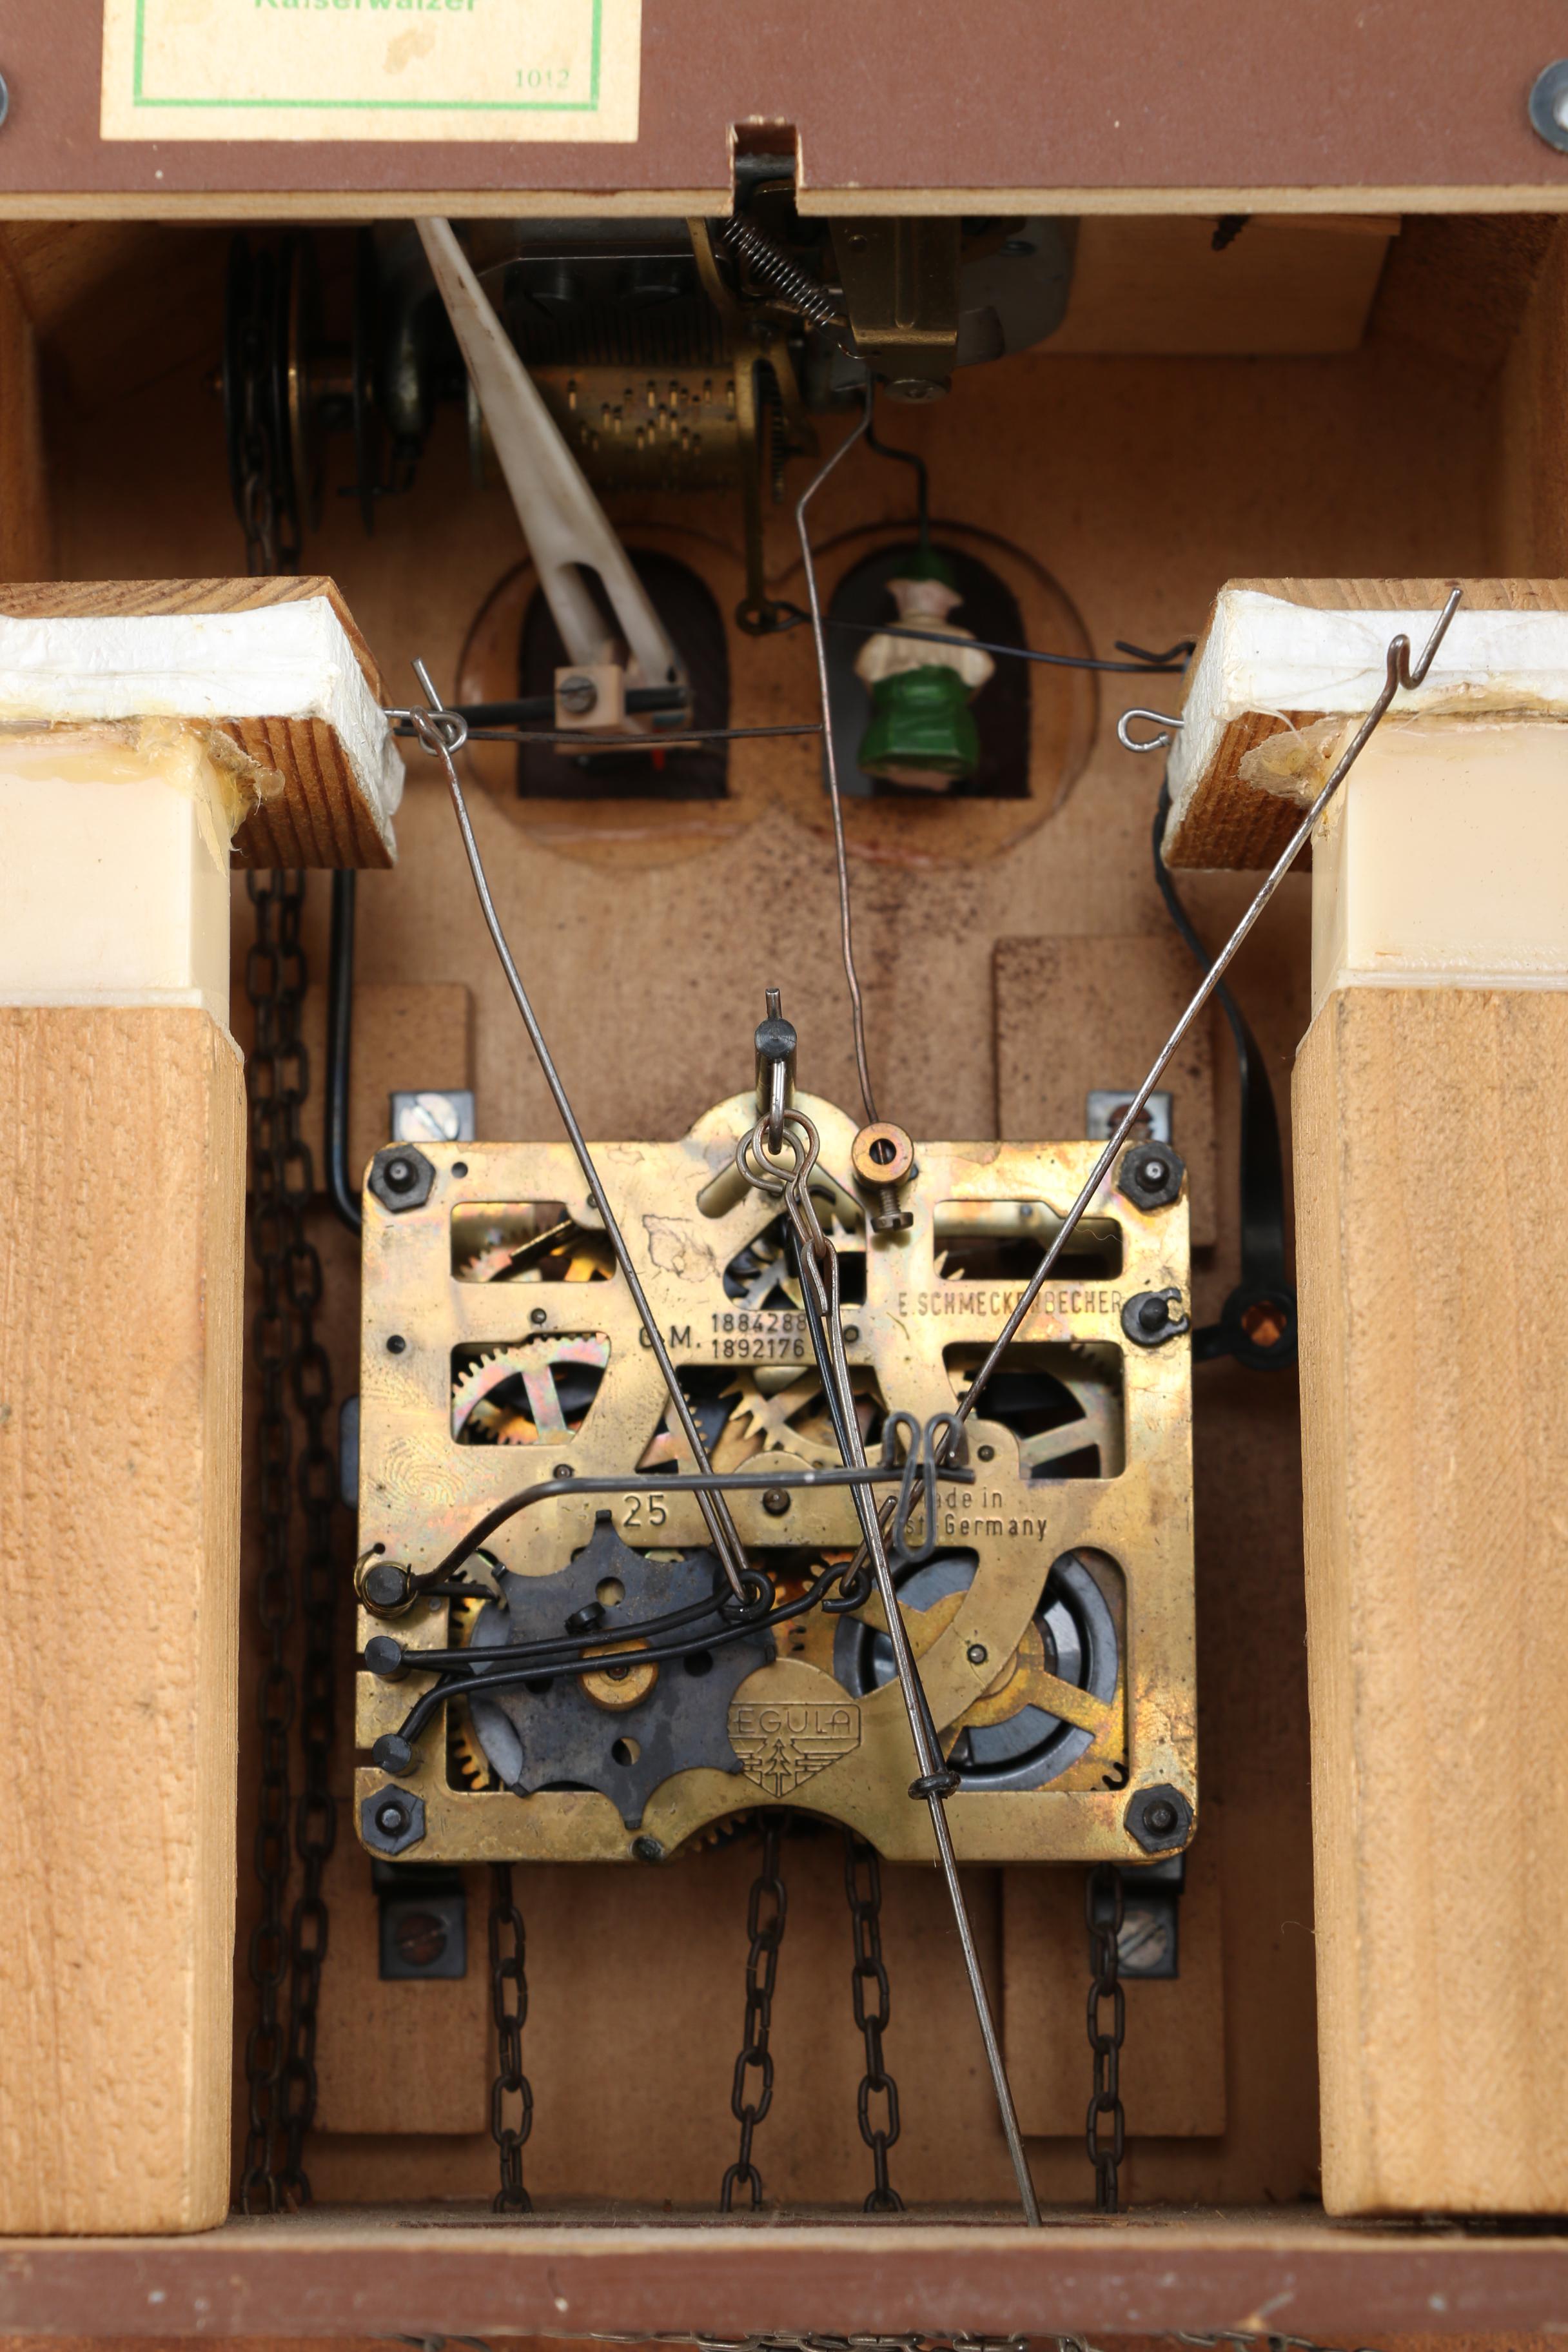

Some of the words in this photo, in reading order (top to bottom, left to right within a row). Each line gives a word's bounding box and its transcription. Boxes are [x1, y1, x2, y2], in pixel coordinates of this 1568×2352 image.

[516, 68, 569, 88] 1012
[711, 1313, 807, 1333] 1884288
[711, 1338, 805, 1358] 1892176
[922, 1487, 972, 1508] ade
[983, 1486, 1003, 1508] in
[623, 1494, 667, 1527] 25
[733, 1709, 850, 1734] EGULA
